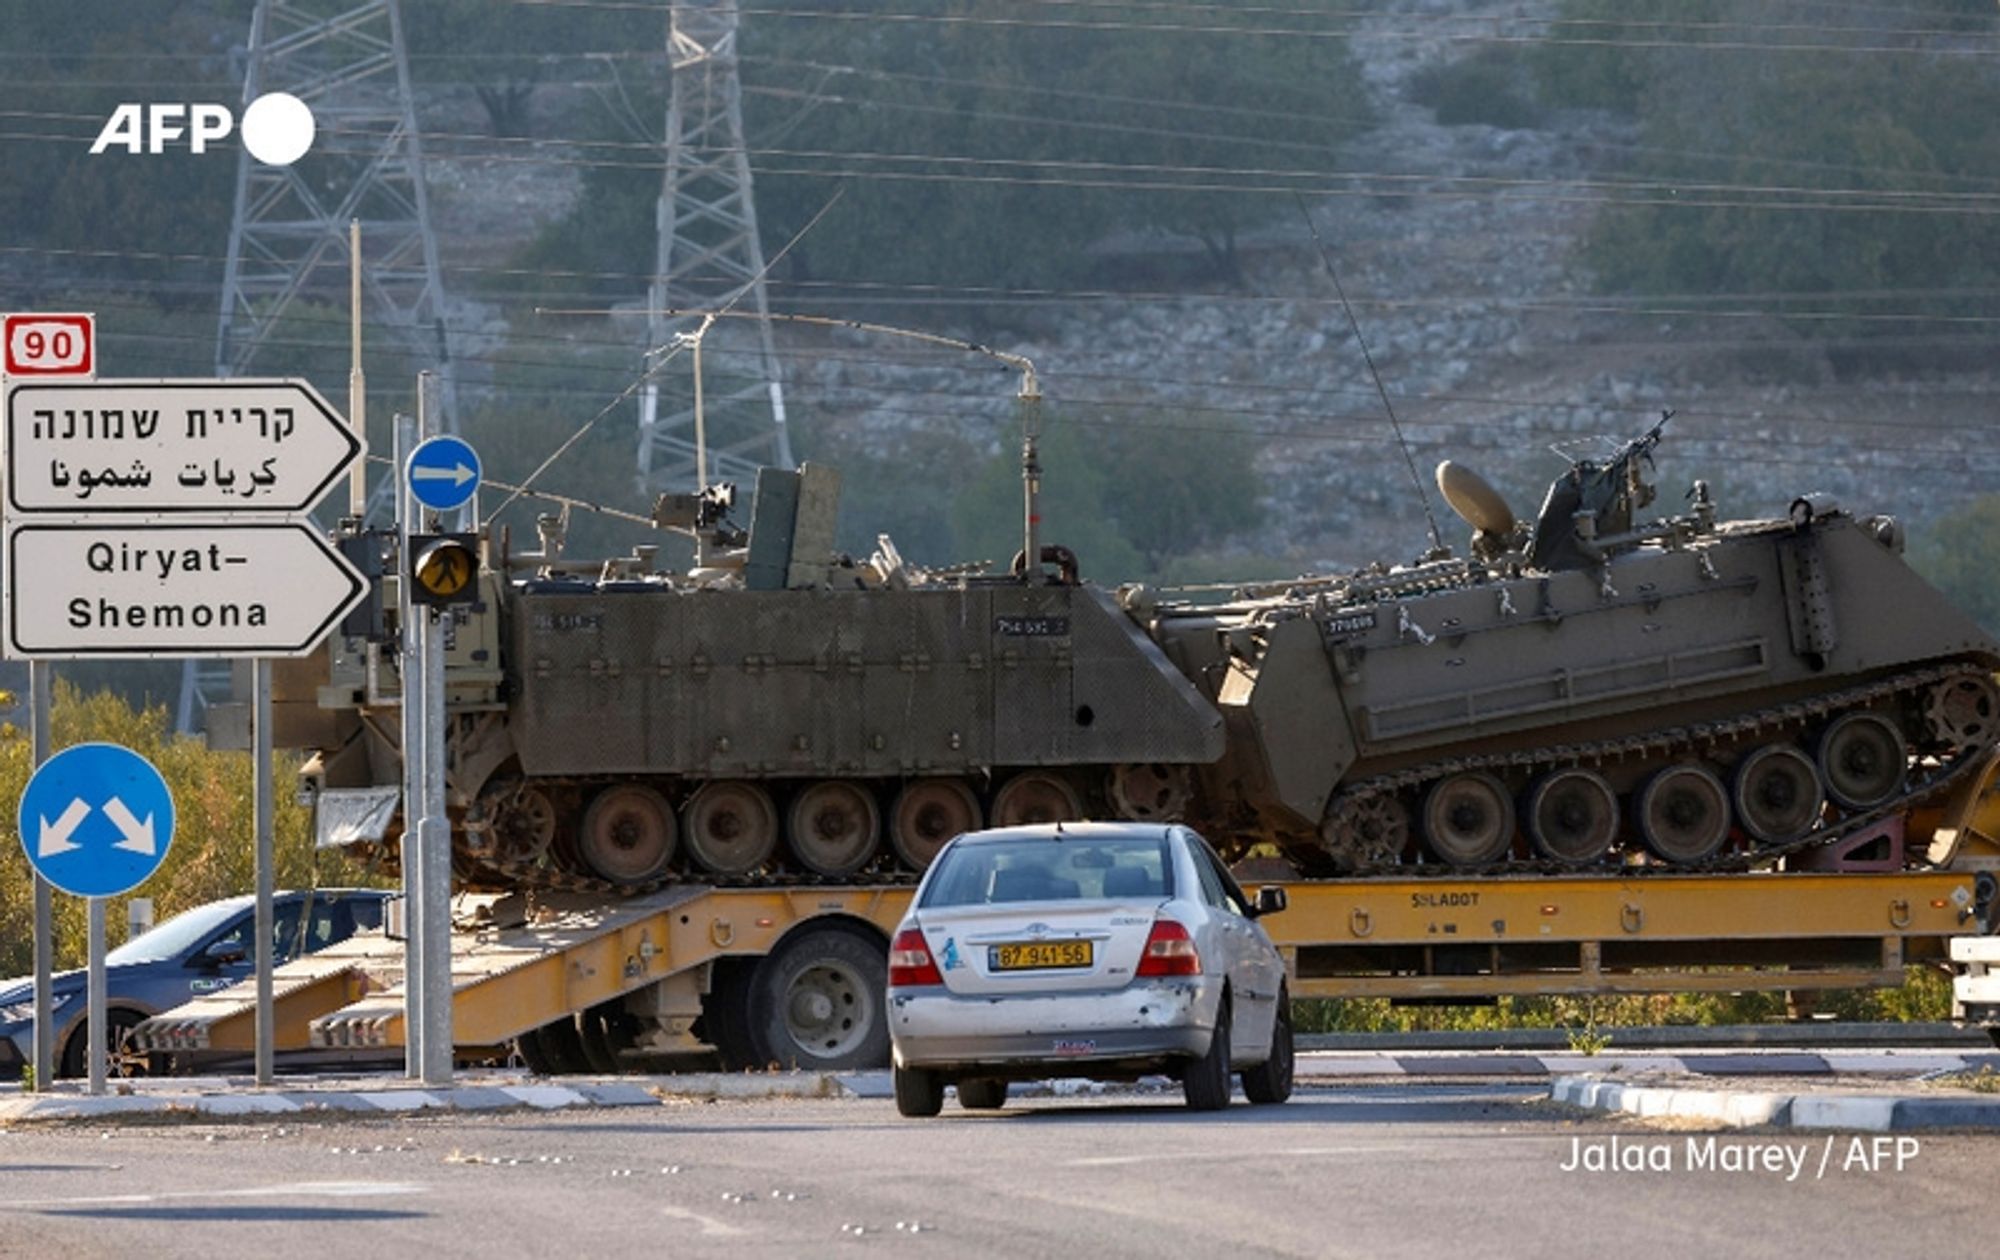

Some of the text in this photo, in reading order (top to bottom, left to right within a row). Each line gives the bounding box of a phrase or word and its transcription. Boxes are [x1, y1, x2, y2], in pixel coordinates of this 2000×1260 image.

[24, 331, 73, 360] 90
[33, 407, 294, 443] קריית שמונה
[50, 459, 152, 499] شمونا
[68, 597, 267, 629] Shemona
